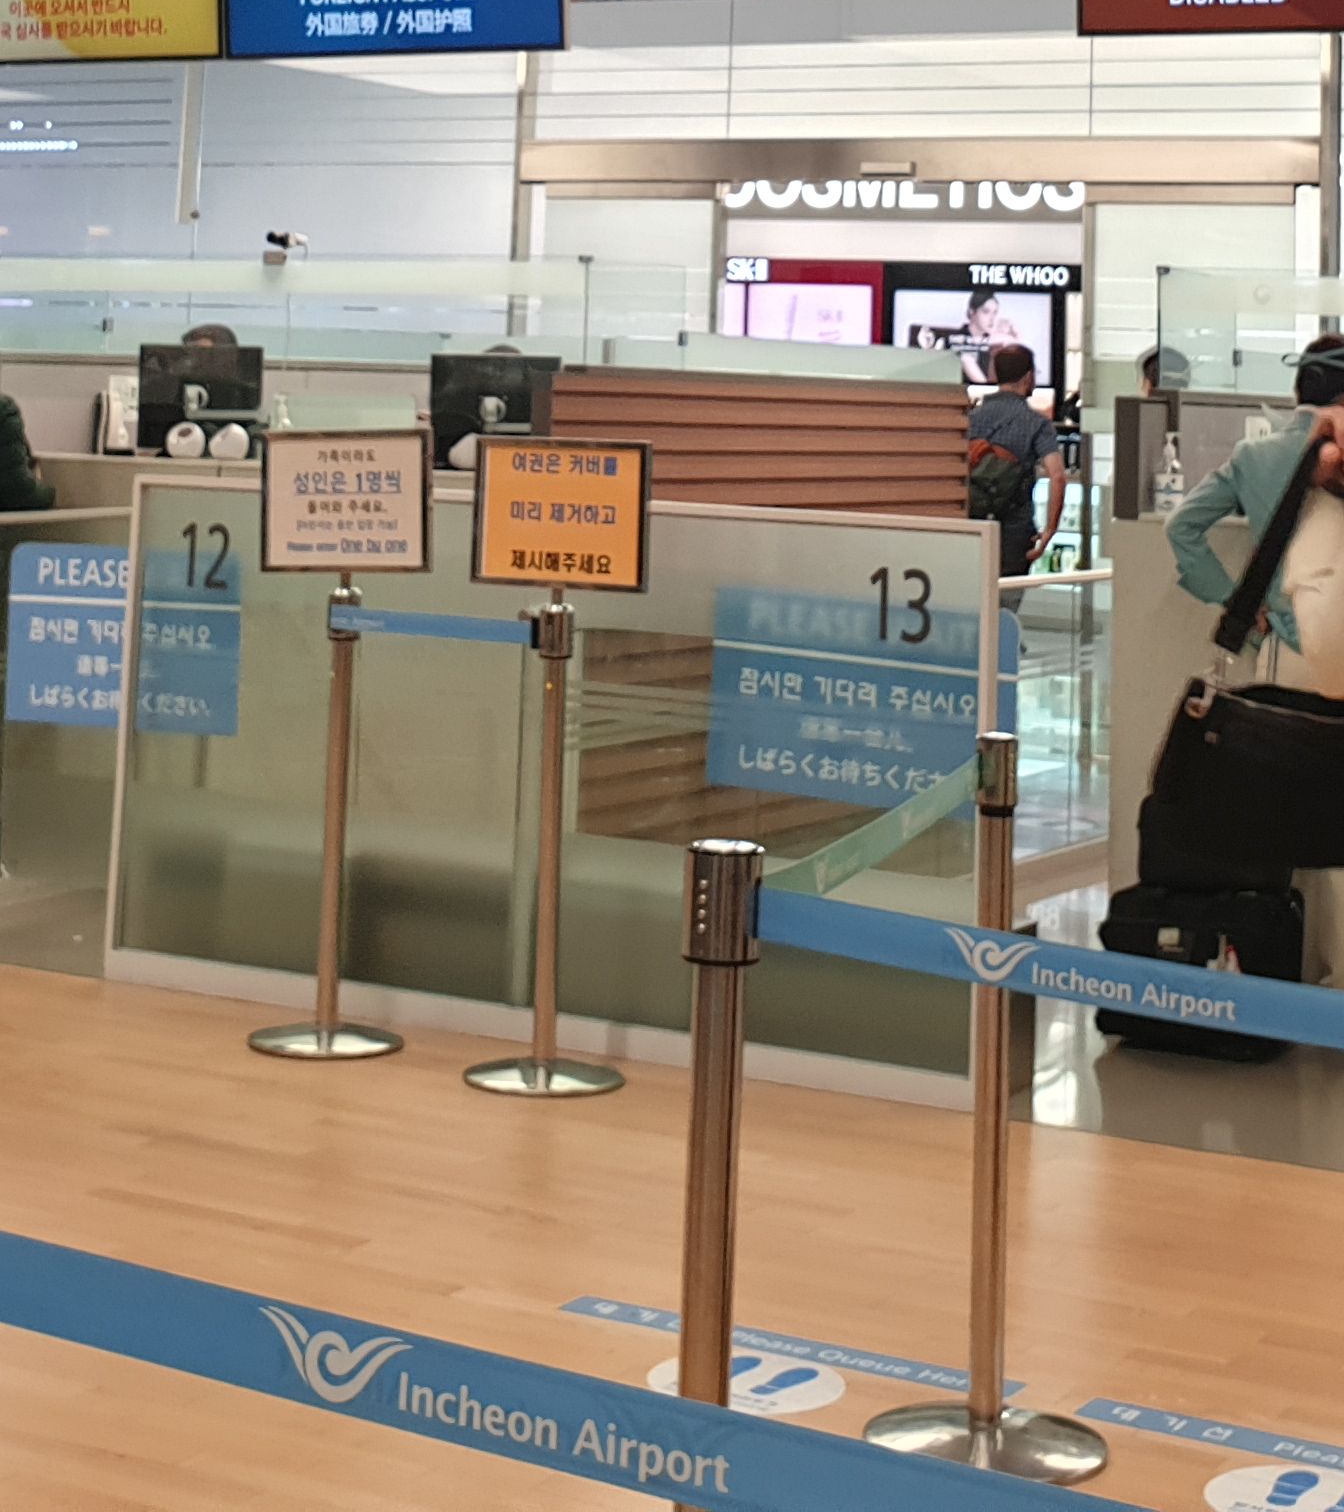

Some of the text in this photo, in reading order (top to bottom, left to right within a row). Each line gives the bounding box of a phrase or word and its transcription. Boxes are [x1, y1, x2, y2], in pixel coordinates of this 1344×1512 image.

[17, 20, 52, 40] 심사를
[57, 18, 107, 40] 받으시기
[111, 17, 167, 37] 바랍니다.
[969, 265, 1069, 286] THE WHOO
[512, 452, 560, 474] 여권은
[294, 471, 401, 494] 성인은 1명씩
[510, 501, 616, 525] 미리 제거하고
[182, 521, 229, 590] 12
[511, 549, 611, 574] 제시해주세요
[38, 557, 128, 588] PLEASE
[870, 566, 932, 644] 13
[87, 619, 126, 644] 기다
[739, 667, 804, 701] 잠시만
[814, 676, 877, 708] 기다려
[739, 743, 945, 791] しばらくお待ちくだ
[1031, 961, 1236, 1022] Incheon Airport
[917, 1367, 971, 1389] Her
[397, 1371, 731, 1494] Incheon Airport
